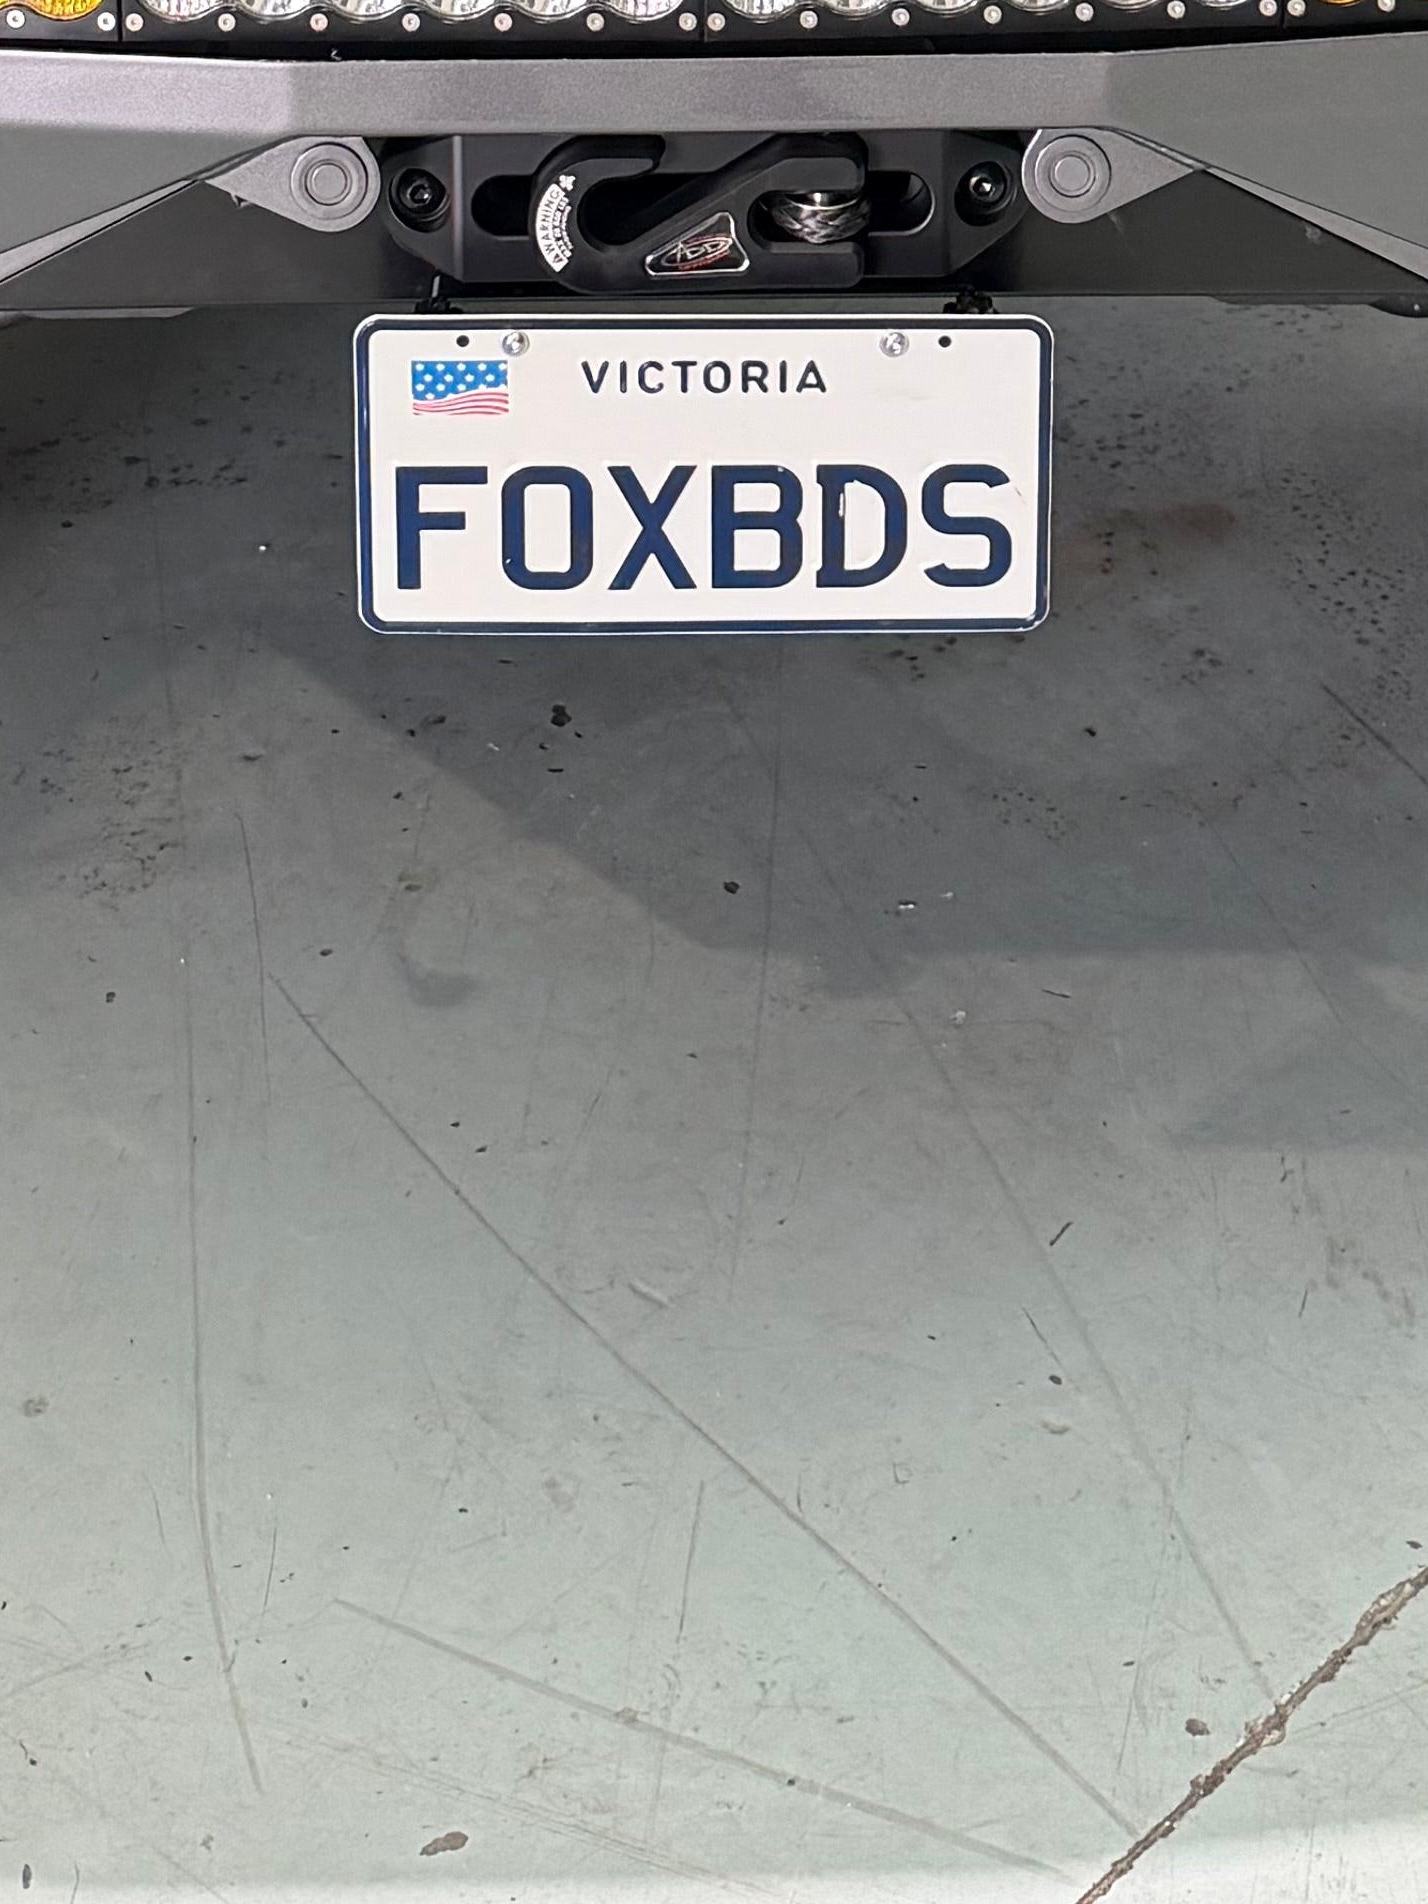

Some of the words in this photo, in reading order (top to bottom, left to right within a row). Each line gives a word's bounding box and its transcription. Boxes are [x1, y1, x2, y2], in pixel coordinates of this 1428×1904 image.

[538, 188, 562, 256] WARNING
[581, 359, 828, 395] VICTORIA
[395, 463, 1013, 591] FOXBDS
